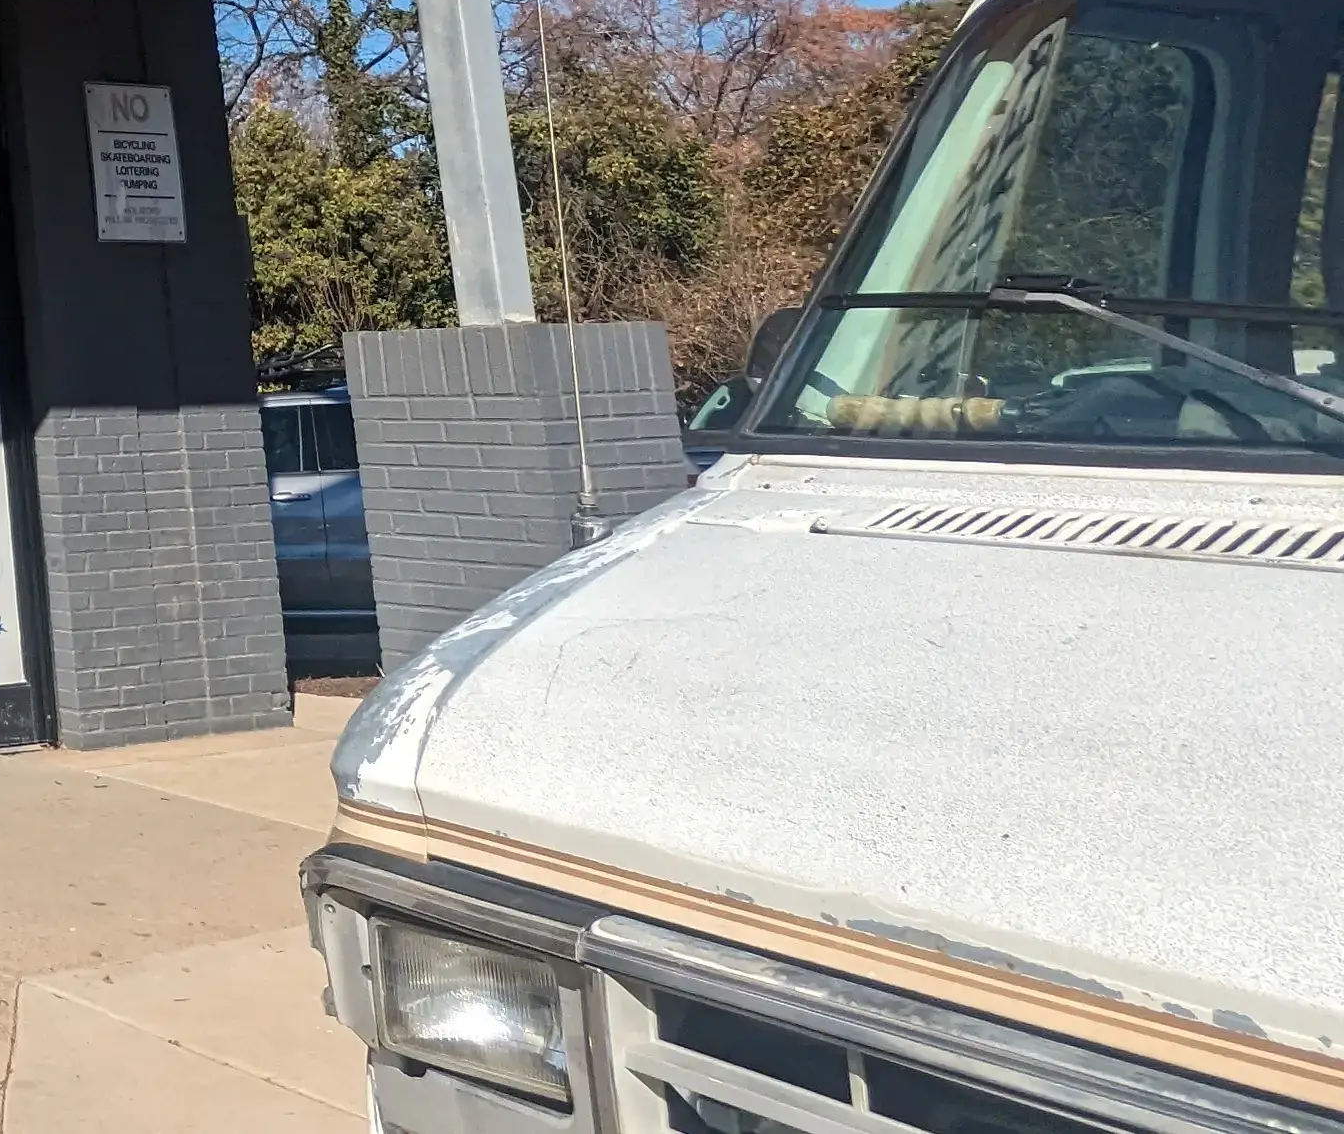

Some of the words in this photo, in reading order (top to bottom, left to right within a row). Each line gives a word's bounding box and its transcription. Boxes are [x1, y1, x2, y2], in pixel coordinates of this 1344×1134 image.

[111, 93, 150, 123] NO
[113, 139, 156, 150] BICYCLING
[100, 152, 171, 164] SKATEBOARDING
[115, 165, 160, 177] LOITERING
